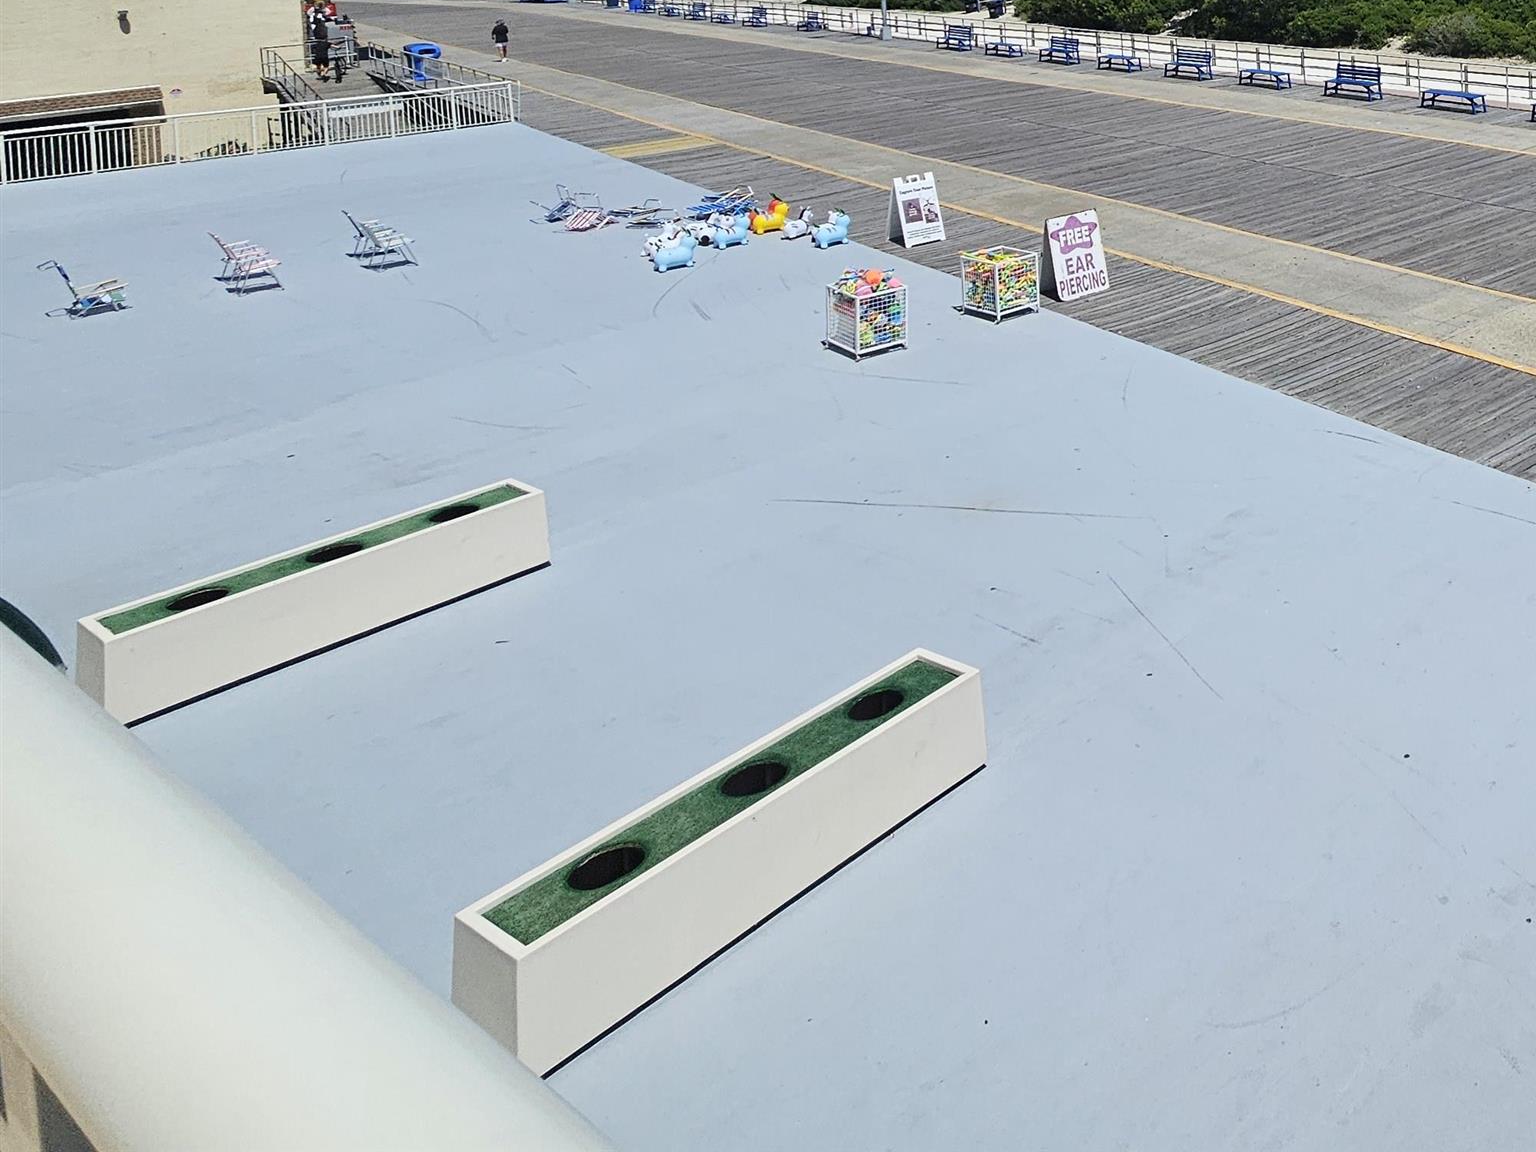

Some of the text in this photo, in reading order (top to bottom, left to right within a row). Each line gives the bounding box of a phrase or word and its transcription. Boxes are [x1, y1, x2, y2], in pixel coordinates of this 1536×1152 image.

[1058, 225, 1091, 248] FREE
[1065, 253, 1095, 276] EAR
[1059, 269, 1107, 298] PIERCING
